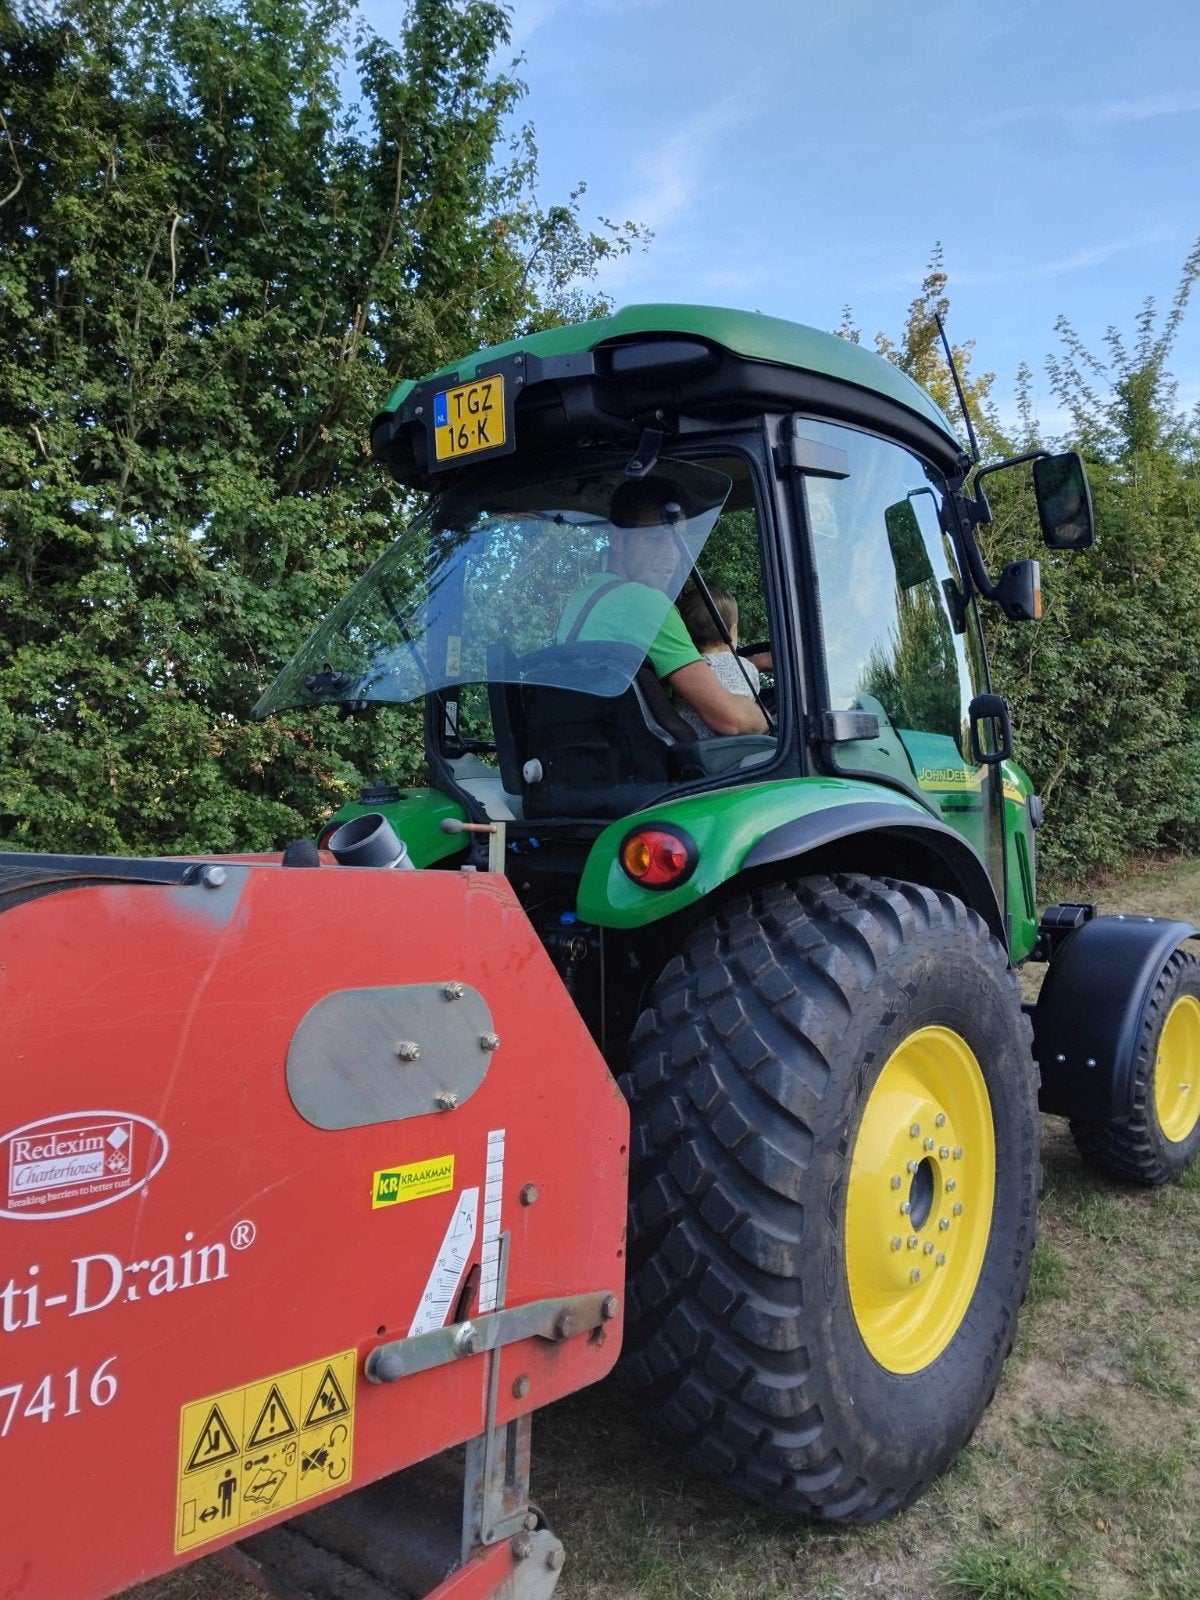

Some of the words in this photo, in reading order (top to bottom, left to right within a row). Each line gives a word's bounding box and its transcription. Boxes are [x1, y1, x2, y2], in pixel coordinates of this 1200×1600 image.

[453, 384, 493, 418] TGZ
[437, 414, 445, 422] NL
[14, 1132, 104, 1163] Redexim
[15, 1159, 102, 1187] Charterhouse
[401, 1165, 452, 1185] KRAAKMAN
[8, 1194, 47, 1208] Breaking
[47, 1190, 79, 1202] barriers
[80, 1186, 89, 1196] to
[90, 1181, 113, 1194] better
[379, 1177, 399, 1195] KR
[465, 1213, 472, 1223] A
[438, 1258, 446, 1268] 70
[425, 1292, 433, 1302] 80
[0, 1356, 117, 1436] 7416
